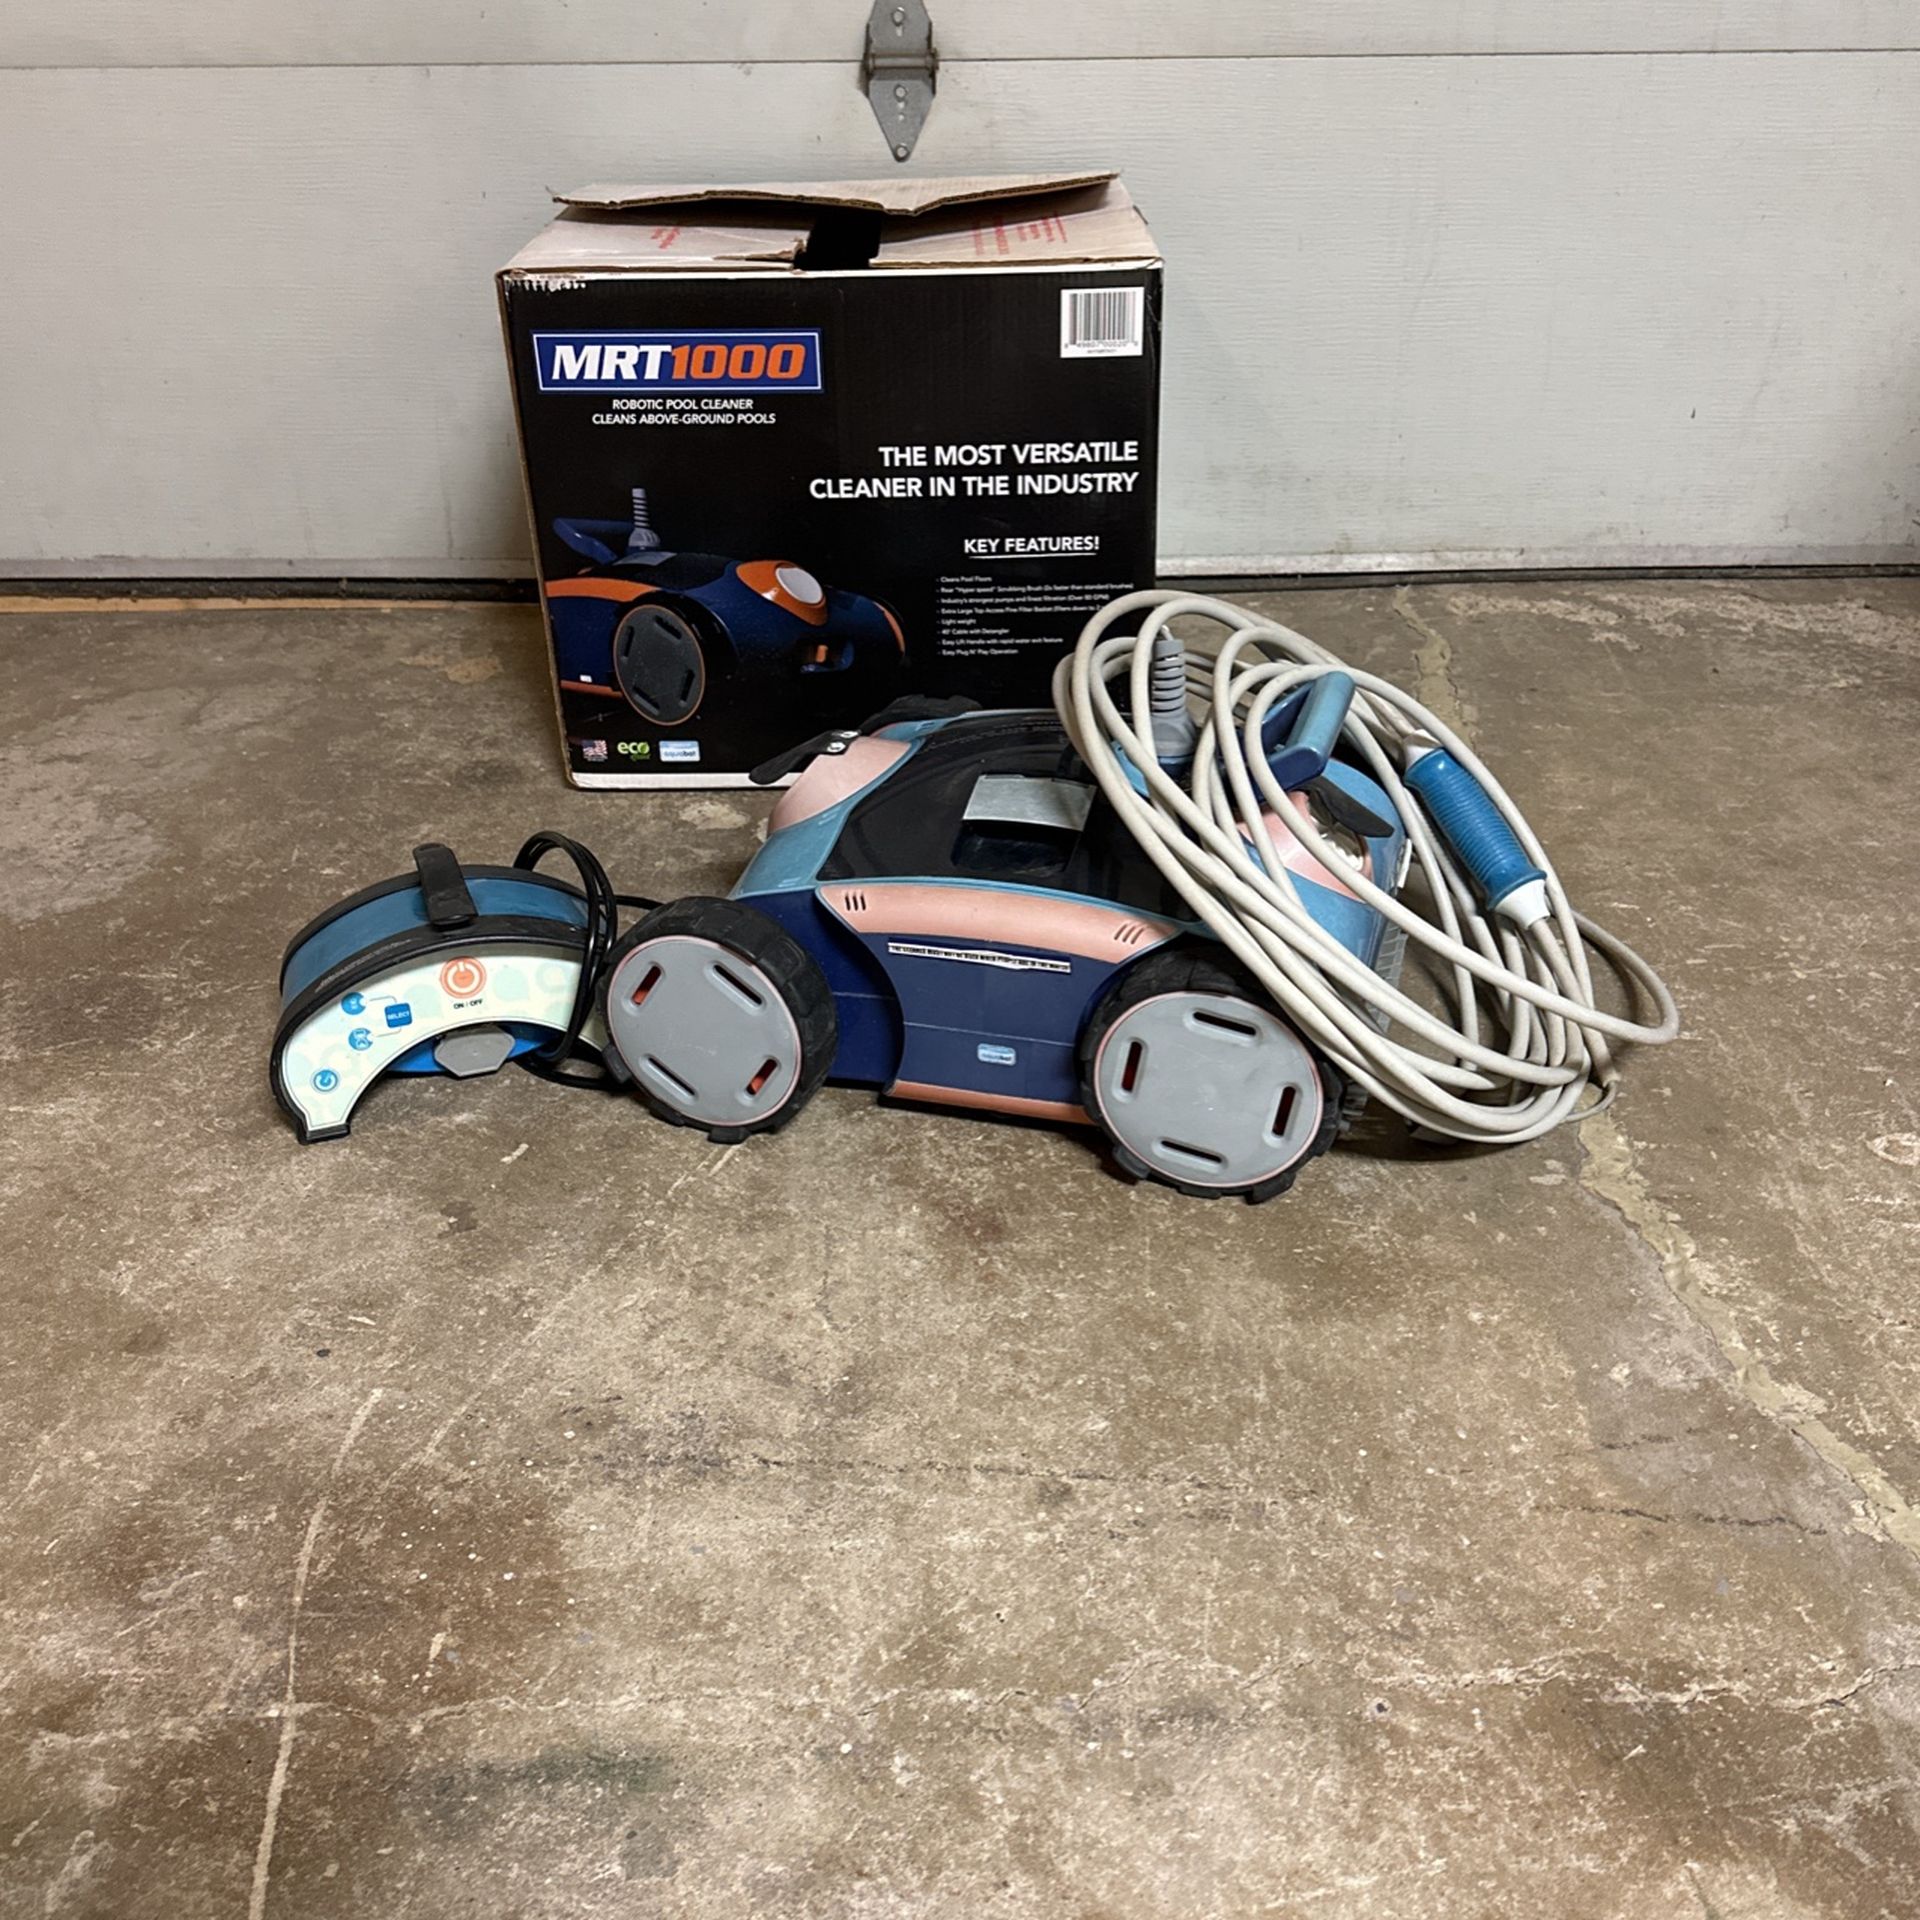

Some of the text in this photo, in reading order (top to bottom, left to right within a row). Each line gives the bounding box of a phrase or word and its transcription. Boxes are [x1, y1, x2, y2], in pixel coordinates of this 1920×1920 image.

[551, 344, 806, 380] MRT1000
[612, 399, 754, 410] ROBOTIC POOL CLEANER
[592, 413, 776, 425] CLEANS ABOVE-GROUND POOLS
[878, 441, 1139, 467] THE MOST VERSATILE
[809, 472, 1139, 499] CLEANER IN THE INDUSTRY
[964, 536, 1100, 553] KEY FEATURES!
[617, 742, 650, 754] eco
[469, 998, 484, 1006] OFF
[387, 1010, 410, 1020] SELECT
